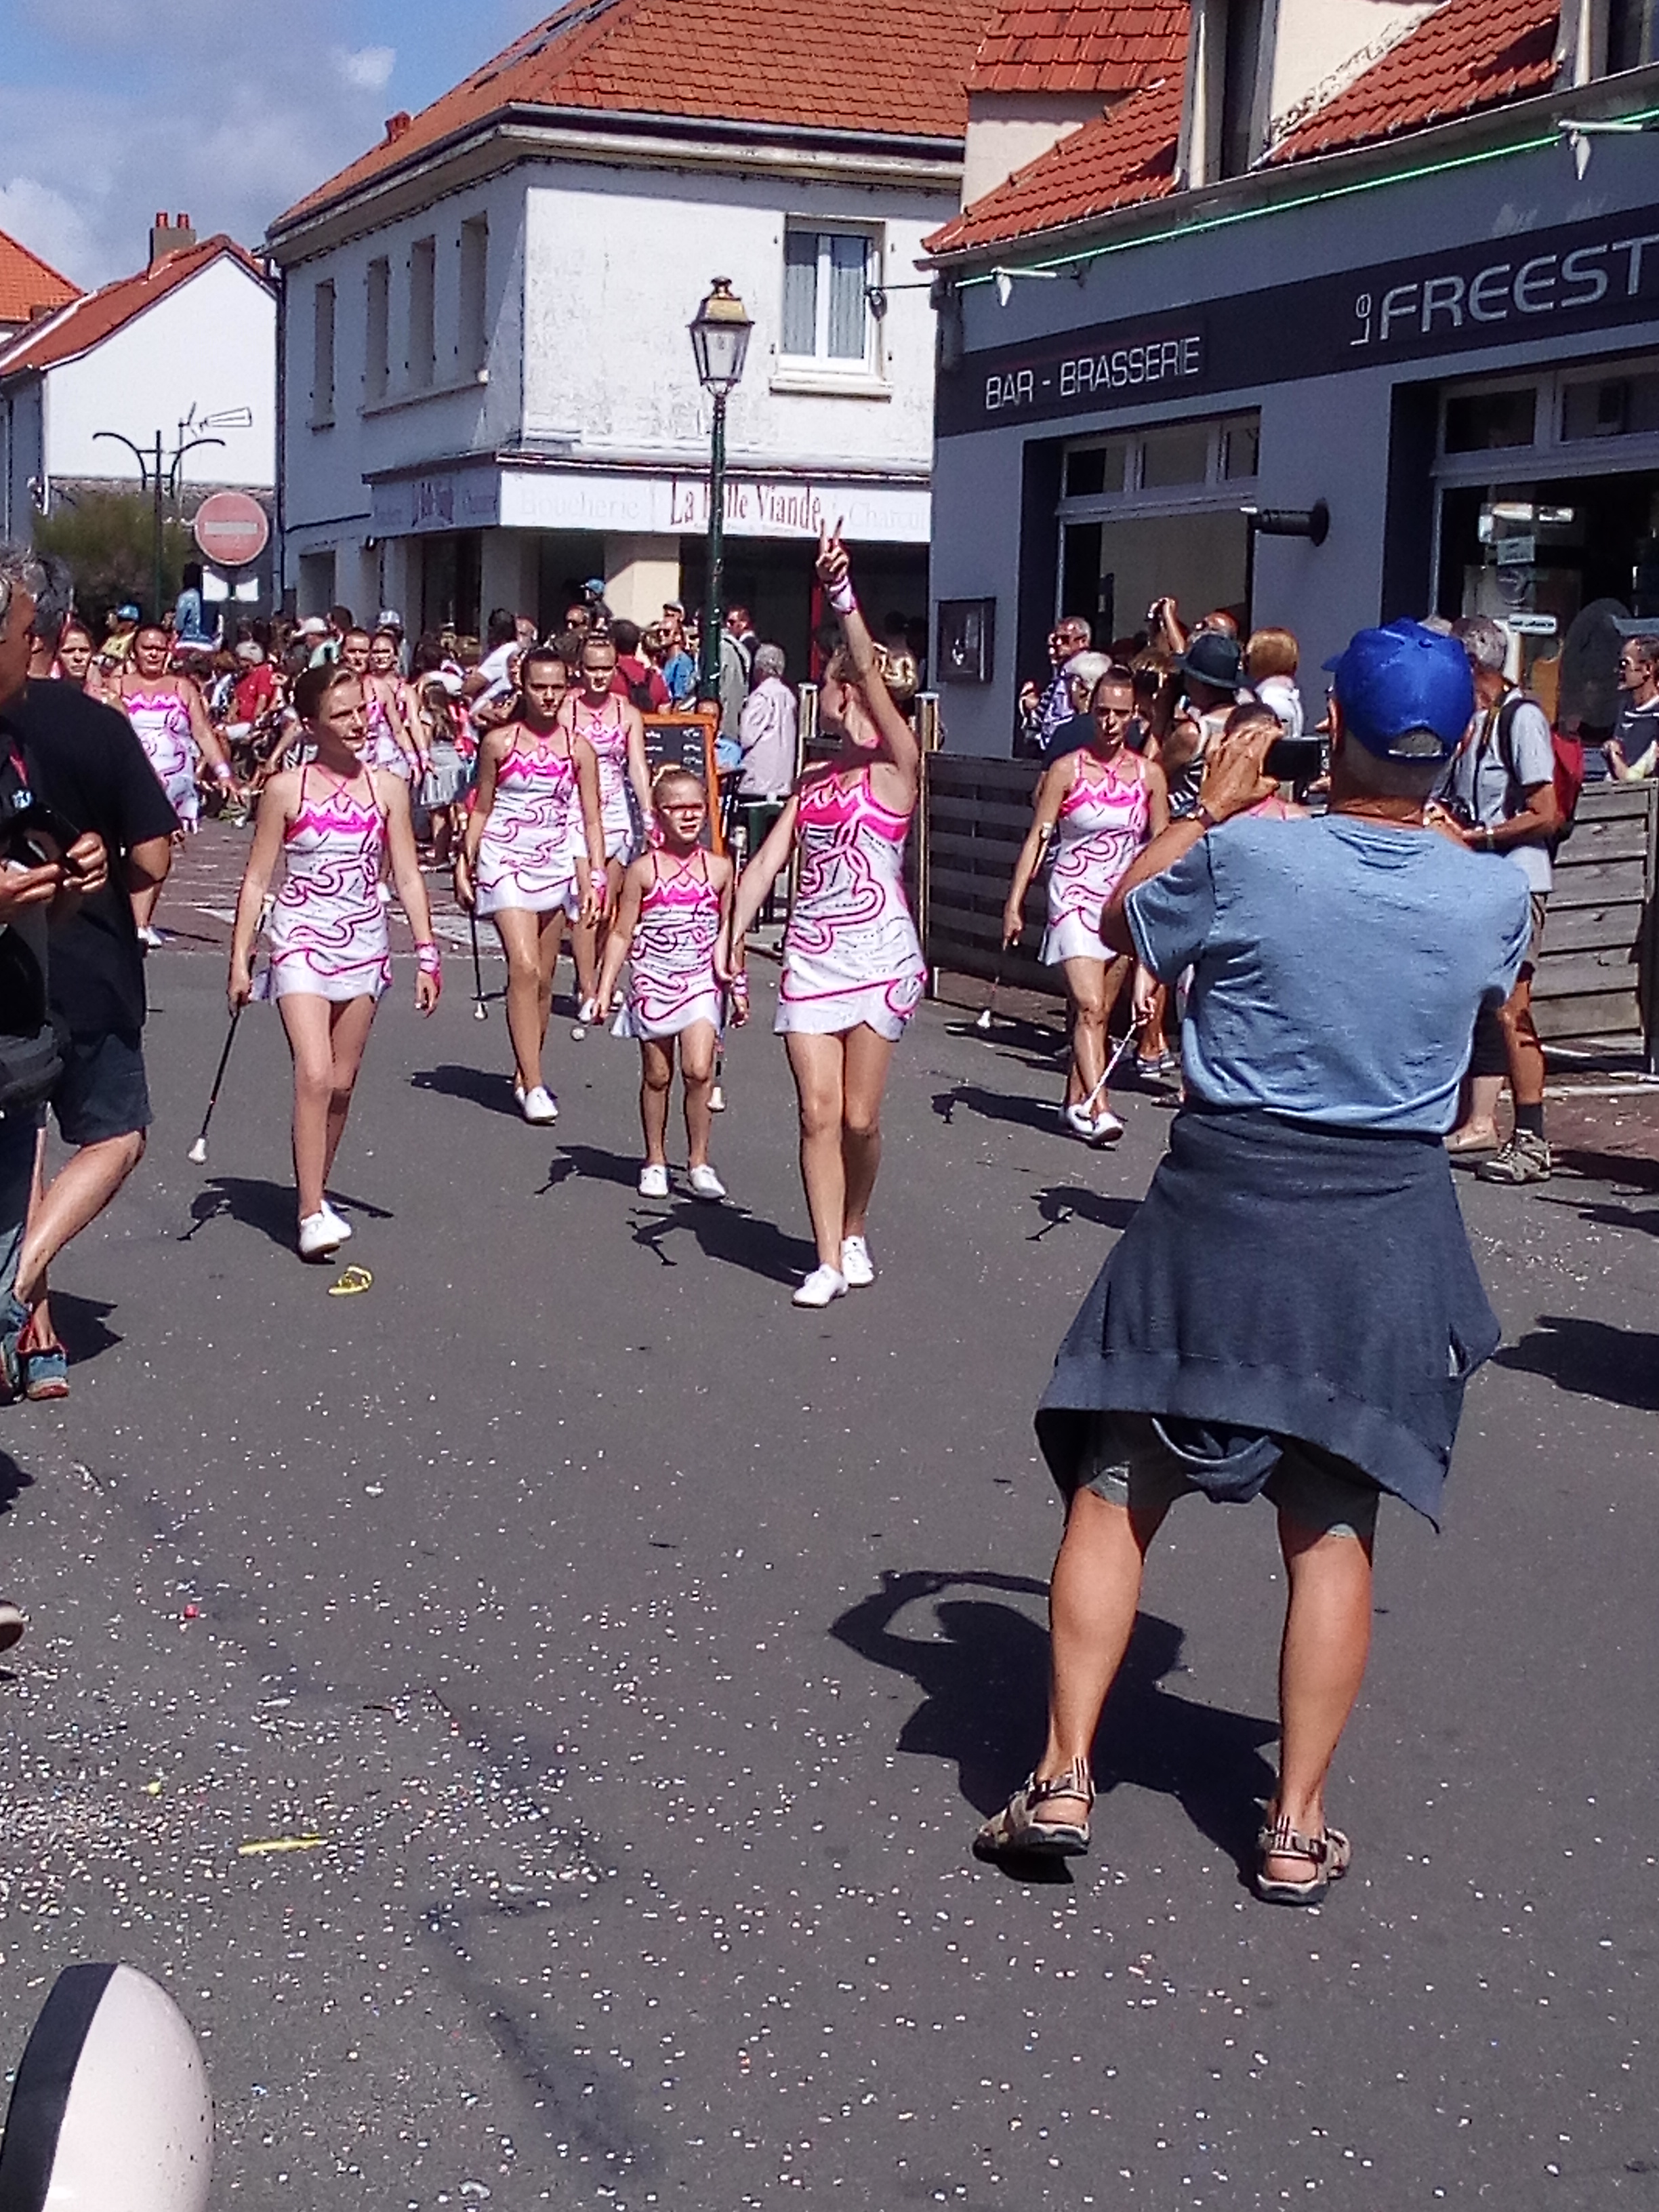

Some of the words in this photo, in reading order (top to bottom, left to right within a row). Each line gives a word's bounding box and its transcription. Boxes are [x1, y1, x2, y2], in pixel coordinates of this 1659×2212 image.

[1378, 234, 1659, 341] FREEST
[985, 369, 1034, 411] BAR
[1061, 337, 1201, 397] BRASSERIE
[670, 476, 694, 525] La
[703, 480, 748, 520] lle
[756, 480, 821, 533] Viande
